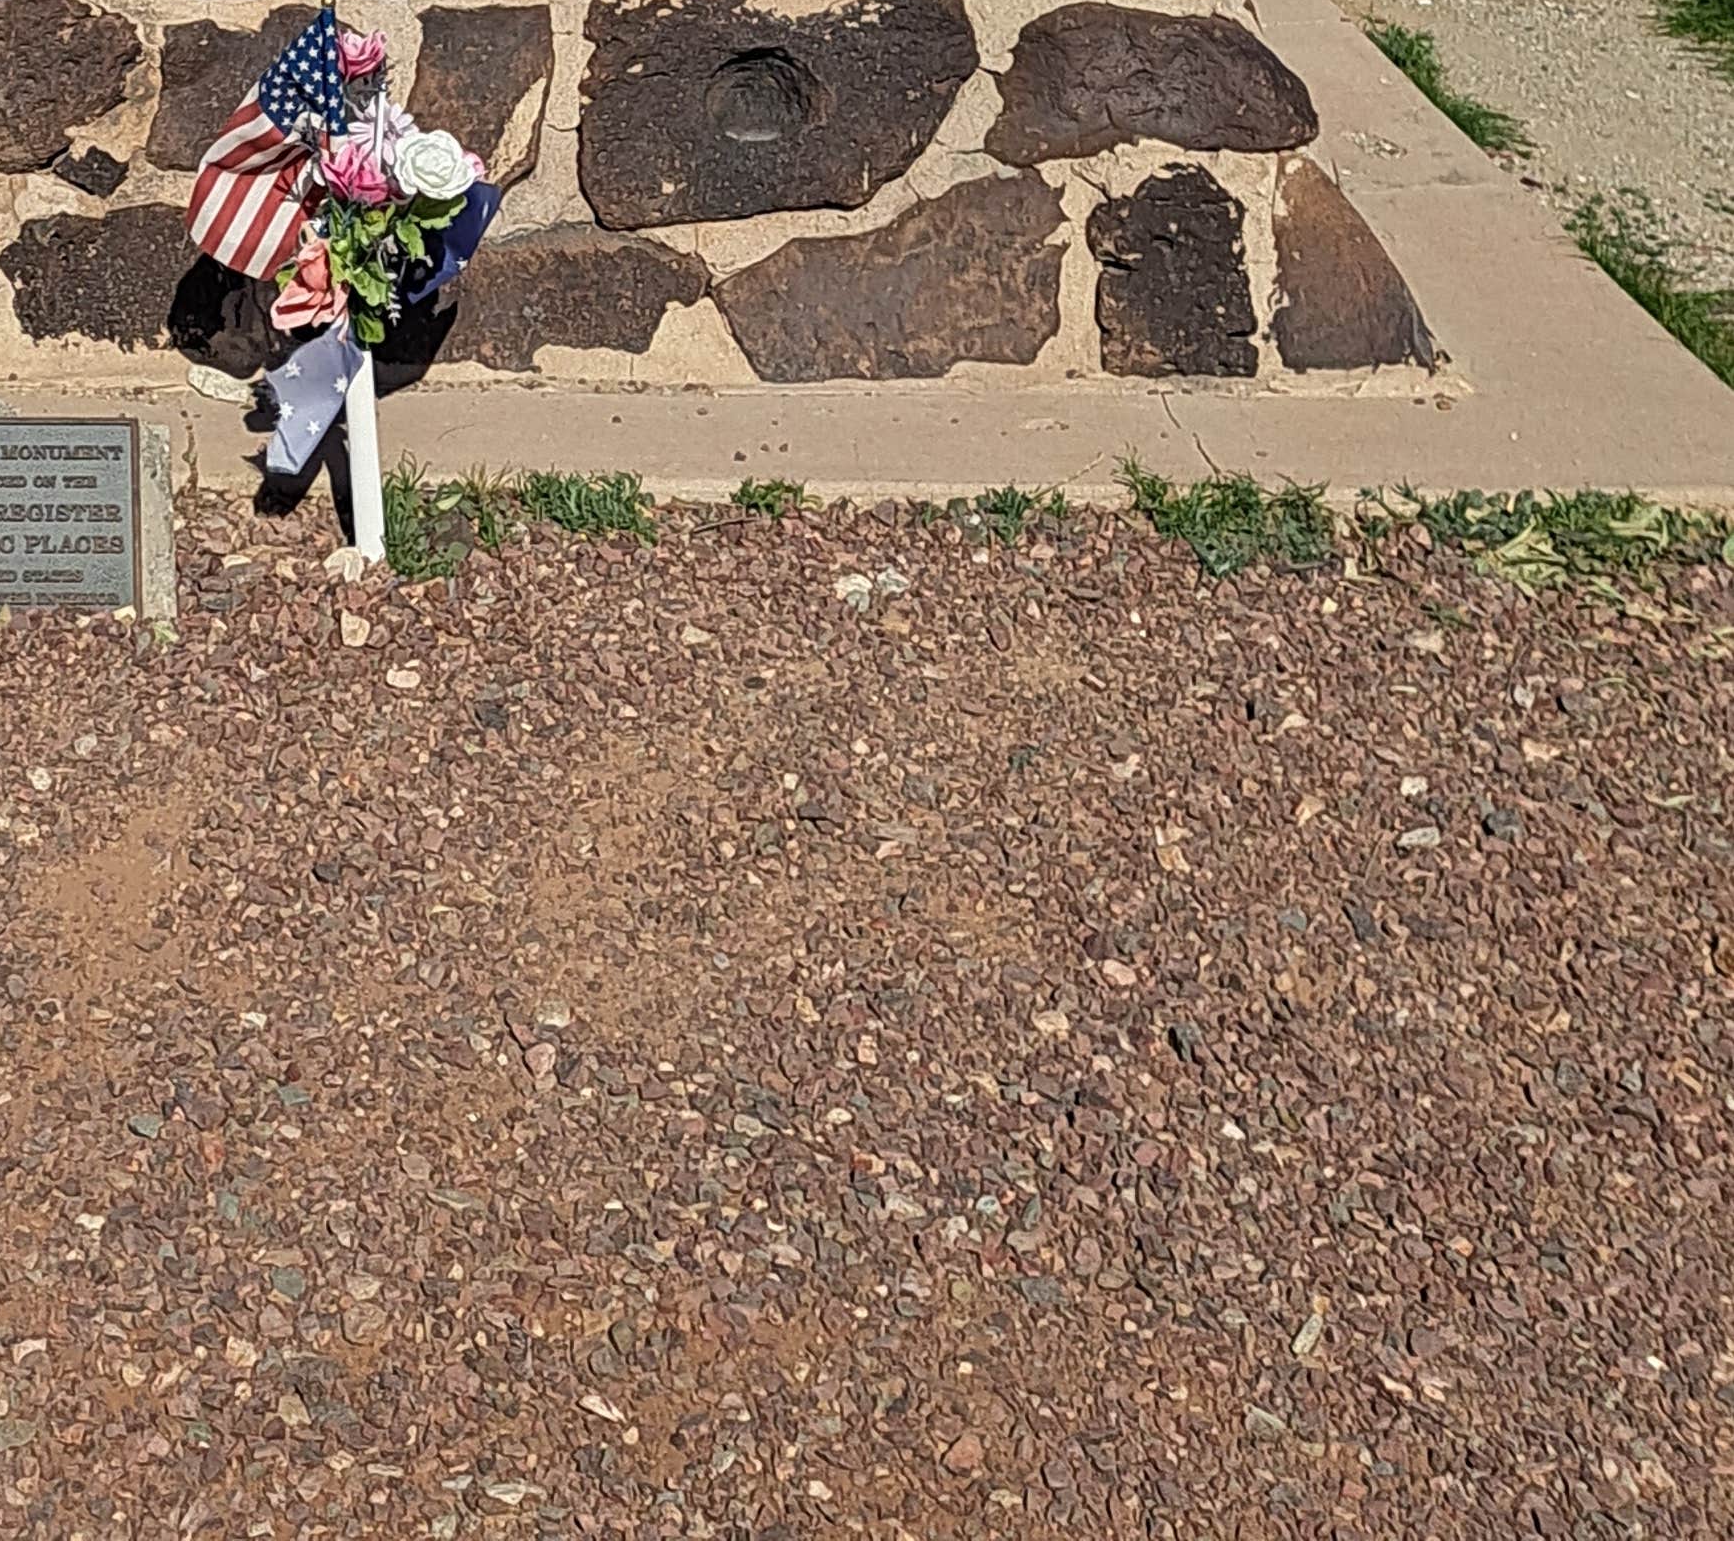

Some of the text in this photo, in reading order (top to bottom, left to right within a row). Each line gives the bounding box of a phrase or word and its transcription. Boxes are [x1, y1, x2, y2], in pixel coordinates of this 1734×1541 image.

[1, 445, 123, 460] MONUMENT
[33, 476, 57, 488] ON
[62, 476, 97, 488] THE
[25, 535, 124, 554] PLACES
[22, 570, 84, 583] STATES
[36, 592, 119, 605] INTERIOR
